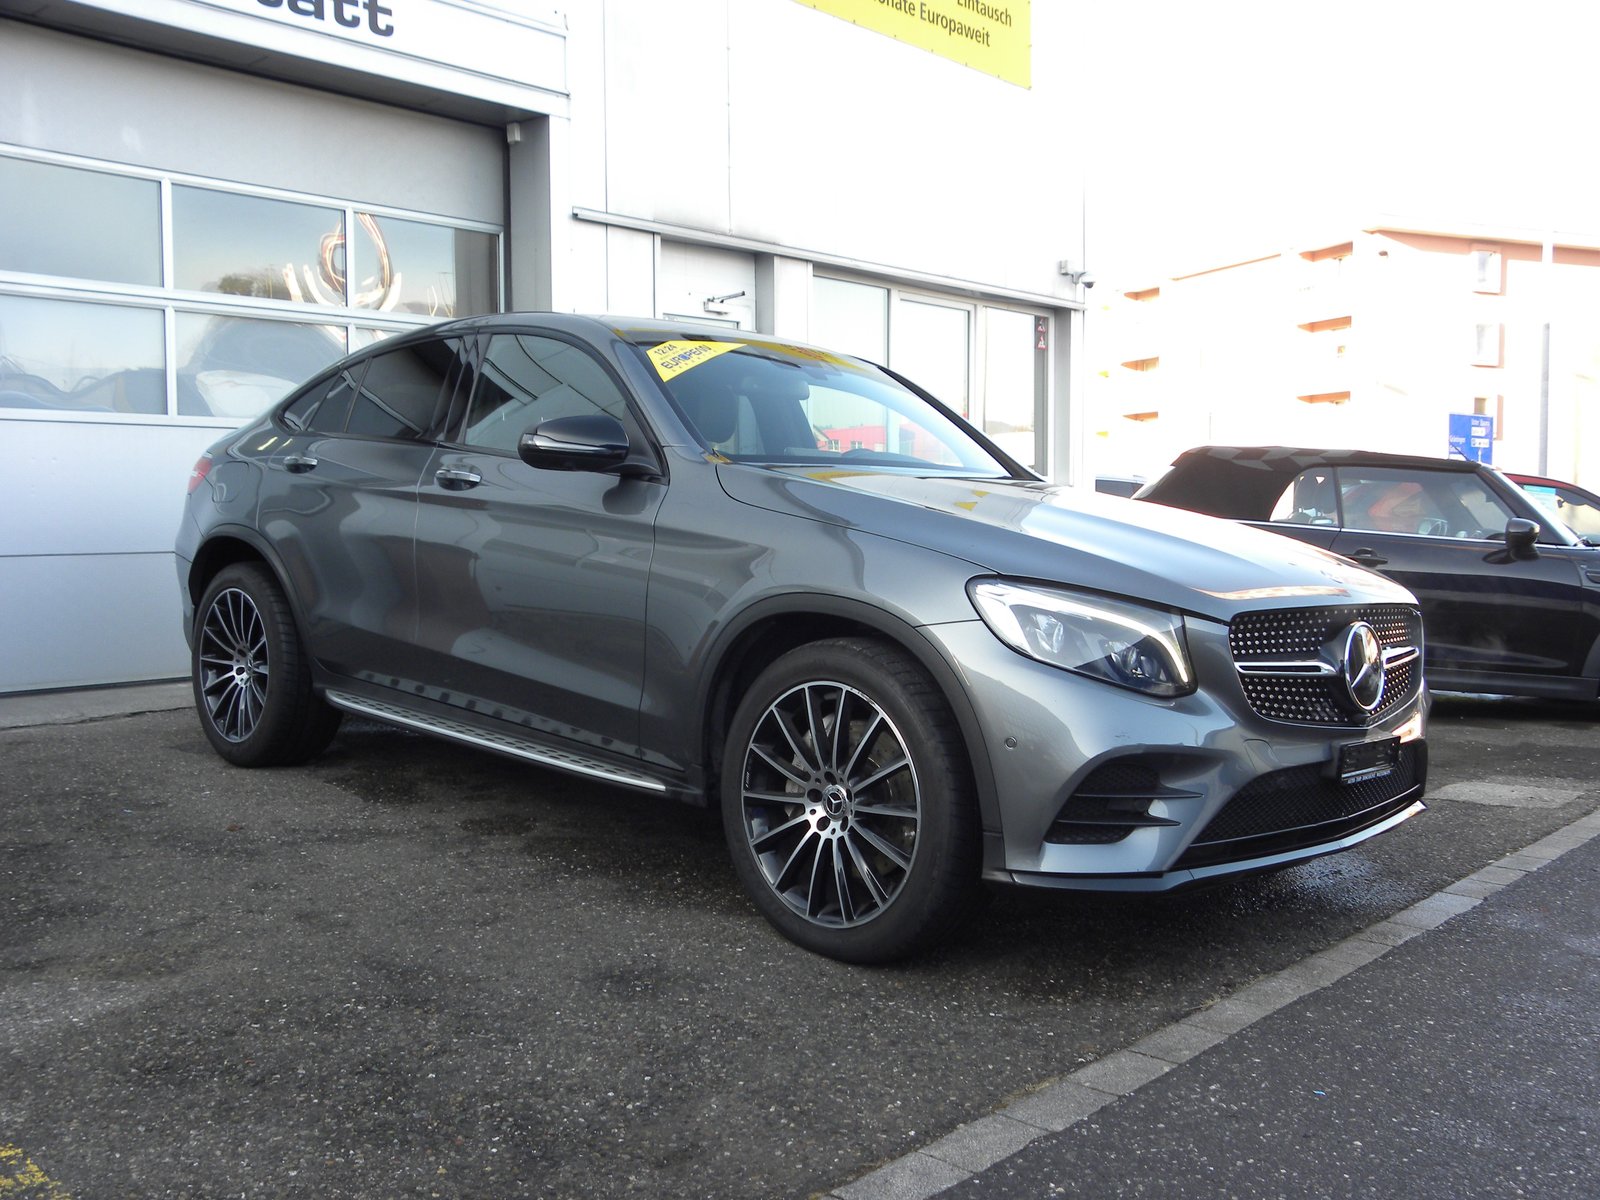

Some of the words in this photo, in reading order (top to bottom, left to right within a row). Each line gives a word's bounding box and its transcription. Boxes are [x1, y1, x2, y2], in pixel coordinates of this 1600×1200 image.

[256, 0, 394, 37] att
[873, 0, 916, 17] nate
[920, 2, 990, 47] Europaweit
